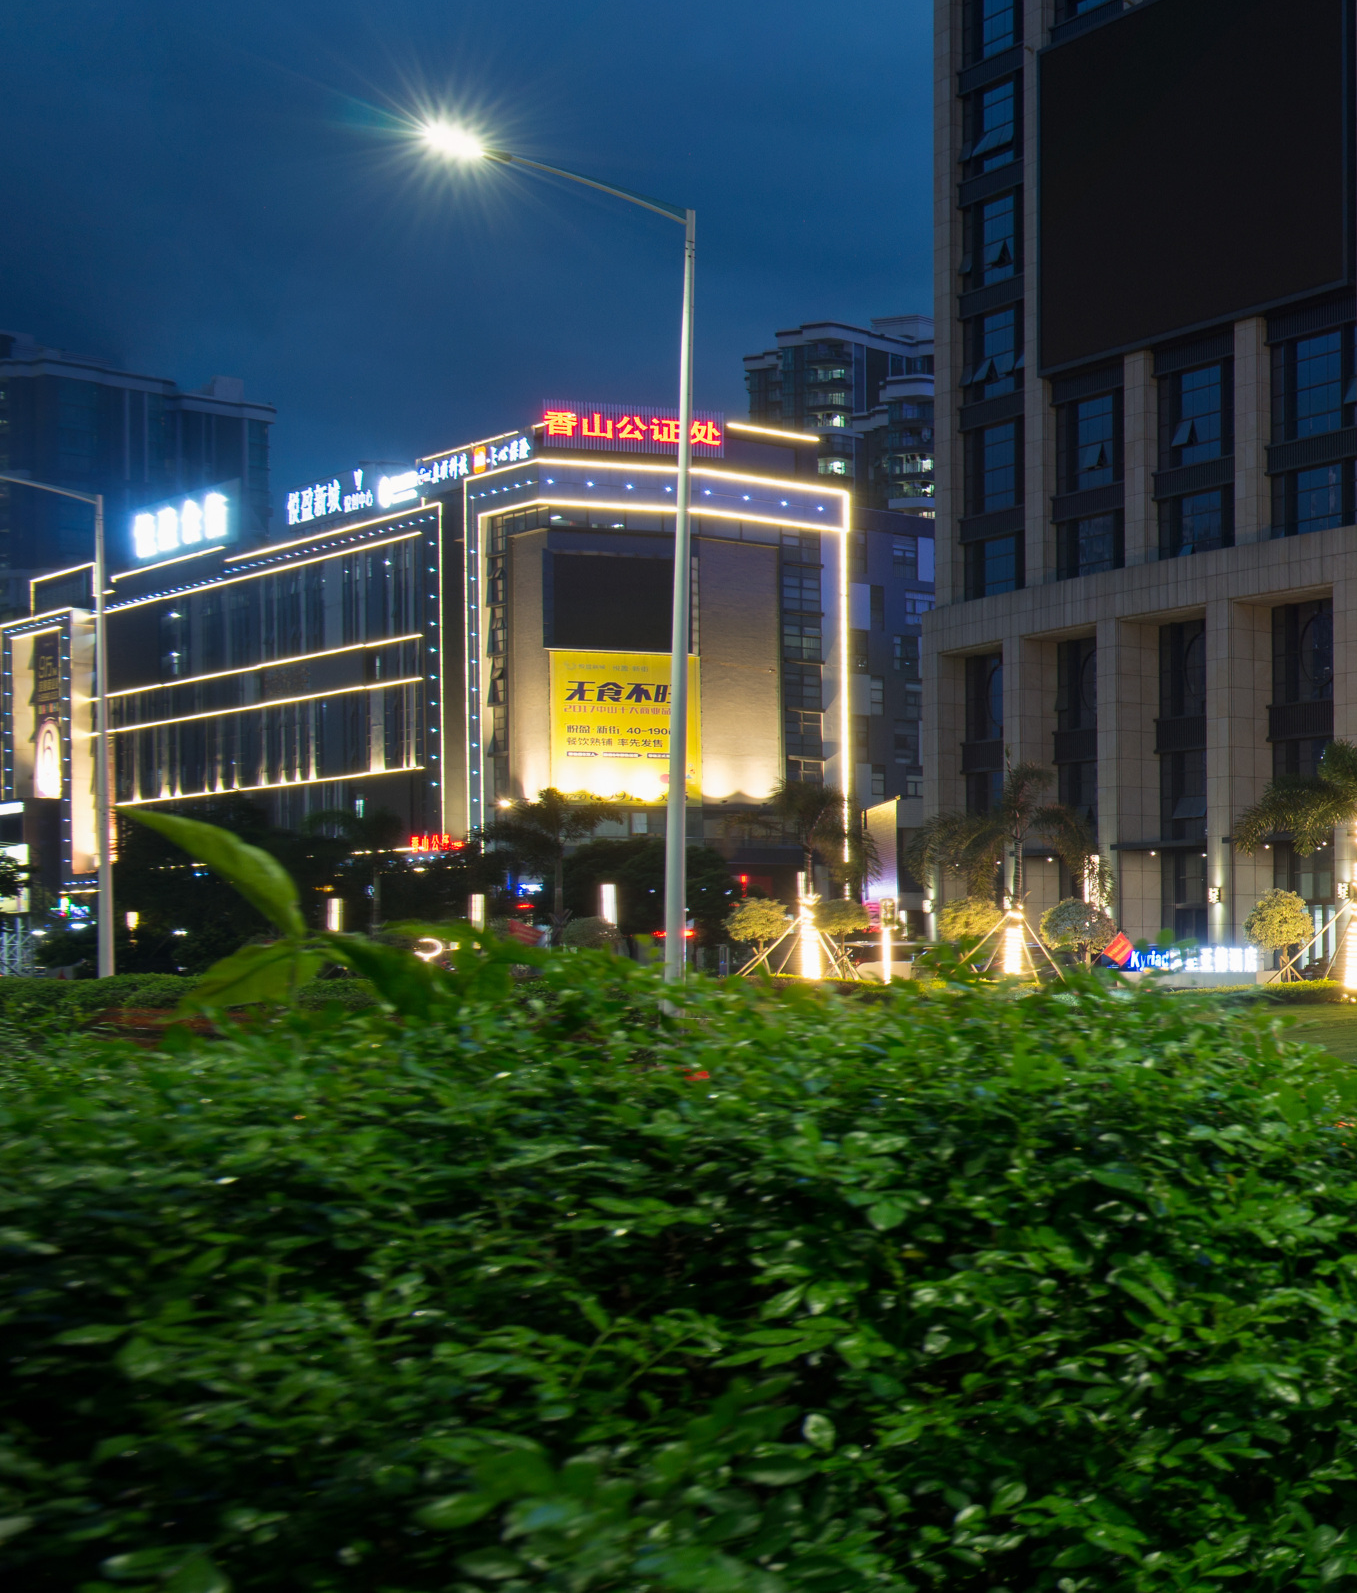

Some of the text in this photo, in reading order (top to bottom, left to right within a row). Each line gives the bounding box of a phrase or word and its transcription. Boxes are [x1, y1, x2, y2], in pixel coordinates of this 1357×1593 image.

[544, 411, 721, 446] 香山公证处
